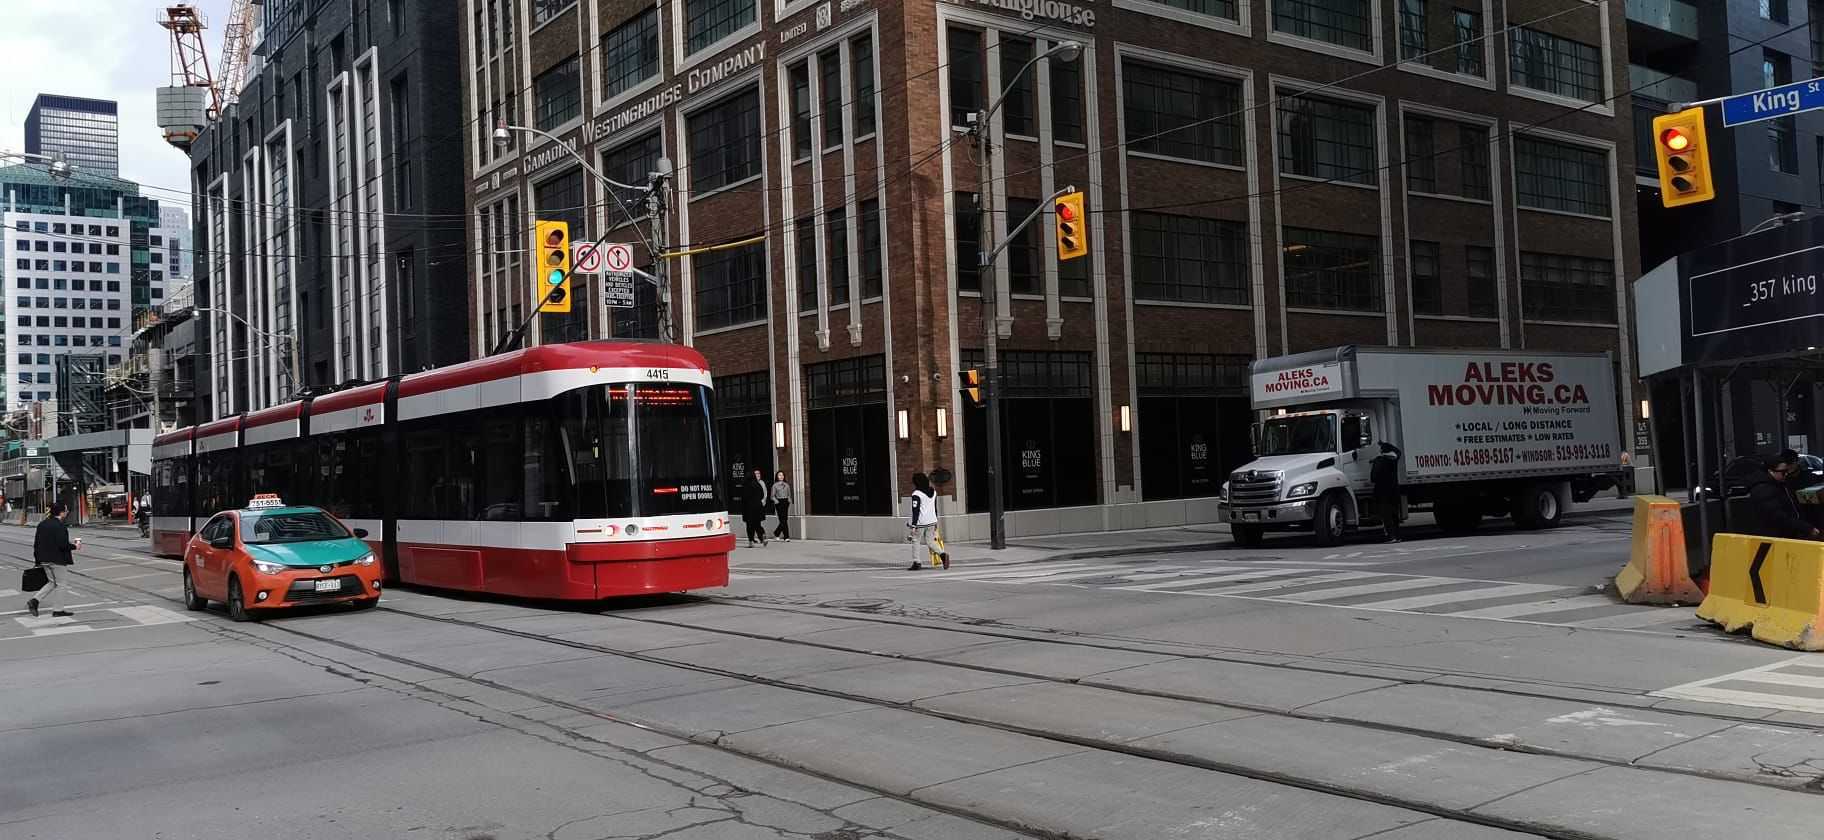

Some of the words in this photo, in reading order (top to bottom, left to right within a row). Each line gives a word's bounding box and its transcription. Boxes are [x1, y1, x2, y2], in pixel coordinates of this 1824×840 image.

[968, 0, 1096, 27] nghouse
[523, 137, 577, 176] CANADIAN
[582, 83, 682, 146] WESTINGHOUSE
[688, 39, 767, 95] COMPANY
[781, 22, 807, 43] LIMITED
[1753, 90, 1800, 112] King
[1808, 82, 1820, 93] St
[1782, 274, 1816, 295] king
[646, 369, 669, 380] 4415
[1278, 368, 1313, 381] ALEKS
[1464, 361, 1554, 383] ALEKS
[1265, 376, 1329, 393] MOVING.CA
[1427, 384, 1589, 406] MOVING.CA
[1533, 406, 1560, 416] Moving
[1561, 405, 1591, 414] Forward
[1462, 422, 1493, 432] LOCAL
[1503, 420, 1527, 431] LONG
[1530, 419, 1573, 430] DISTANCE
[1463, 435, 1484, 444] FREE
[1485, 433, 1526, 443] ESTIMATES
[1534, 433, 1551, 441] LOW
[1552, 432, 1574, 441] RATES
[1022, 450, 1041, 459] KING
[1415, 454, 1451, 468] TORONTO:
[1453, 447, 1514, 466] 416-889-5167
[1521, 449, 1555, 463] WINDSOR:
[842, 457, 858, 466] KING
[1022, 459, 1041, 468] BLUE
[842, 466, 858, 475] BLUE
[689, 484, 700, 492] NOT
[697, 492, 713, 500] DOORS
